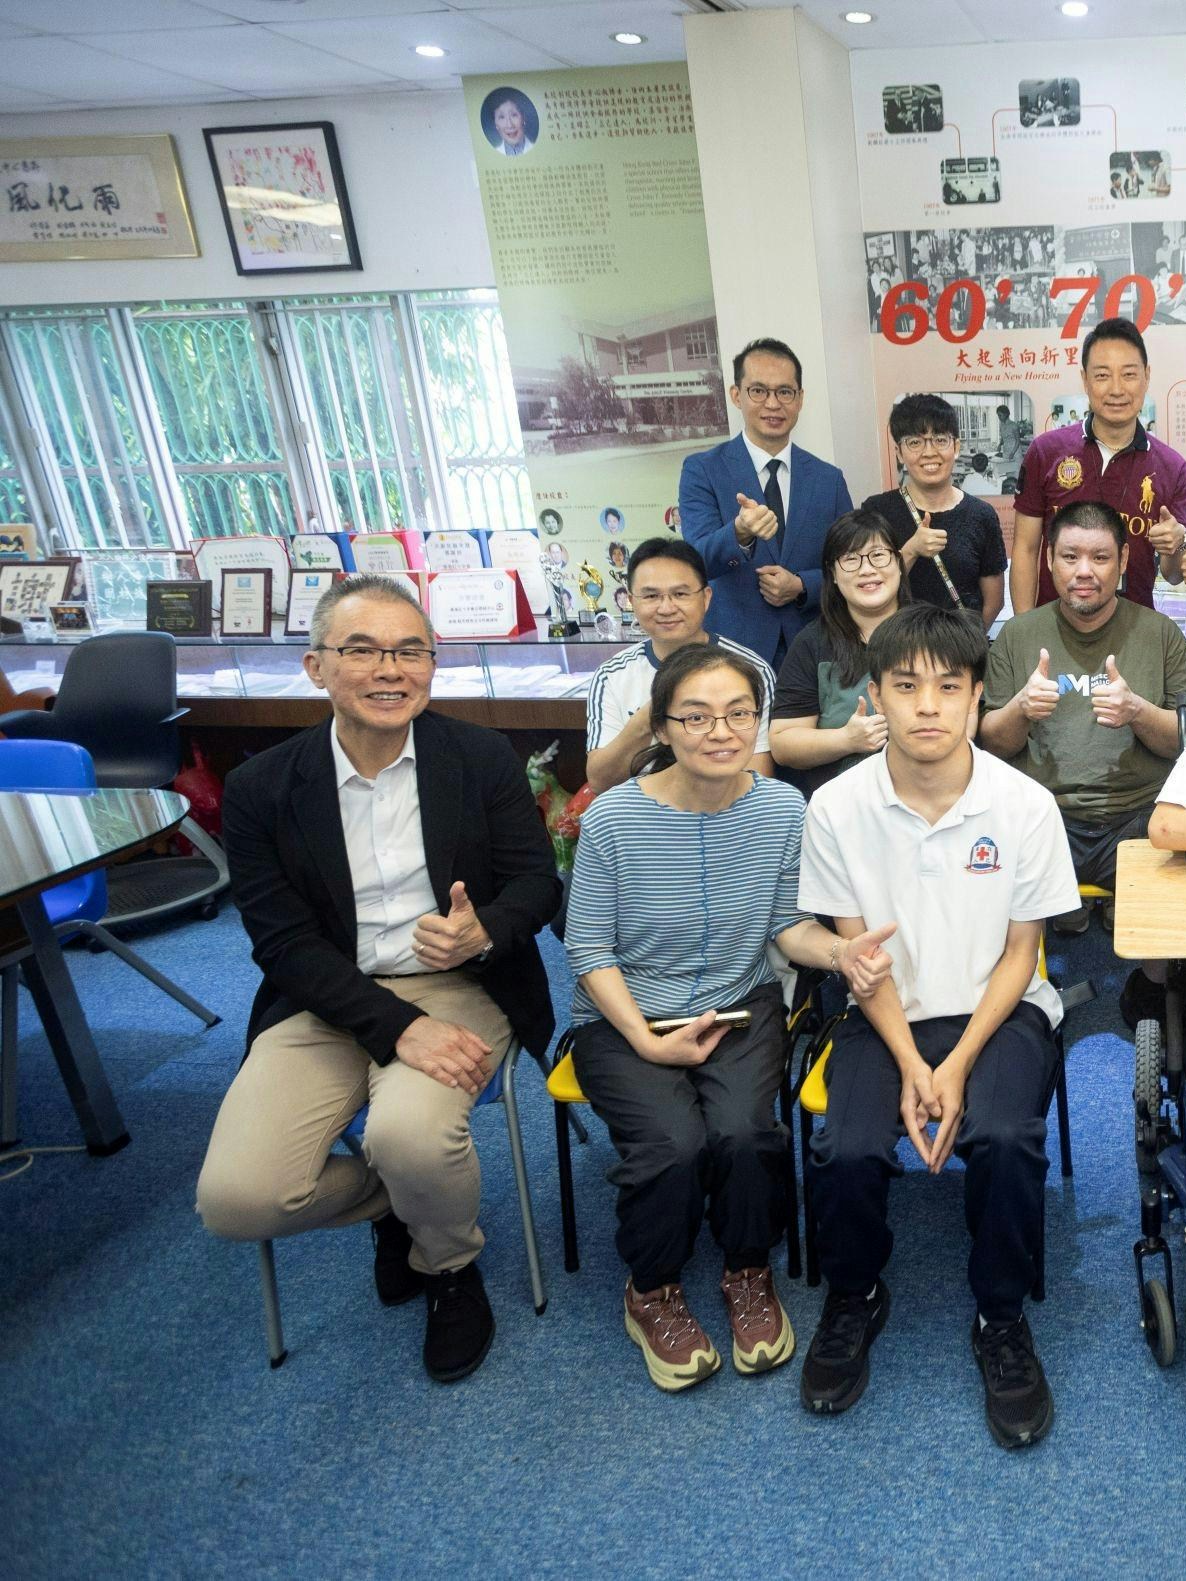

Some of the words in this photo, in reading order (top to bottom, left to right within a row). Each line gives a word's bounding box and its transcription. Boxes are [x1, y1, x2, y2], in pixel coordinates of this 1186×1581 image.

[954, 373, 982, 384] Flying
[1003, 372, 1023, 381] New
[1024, 371, 1060, 381] Horizon
